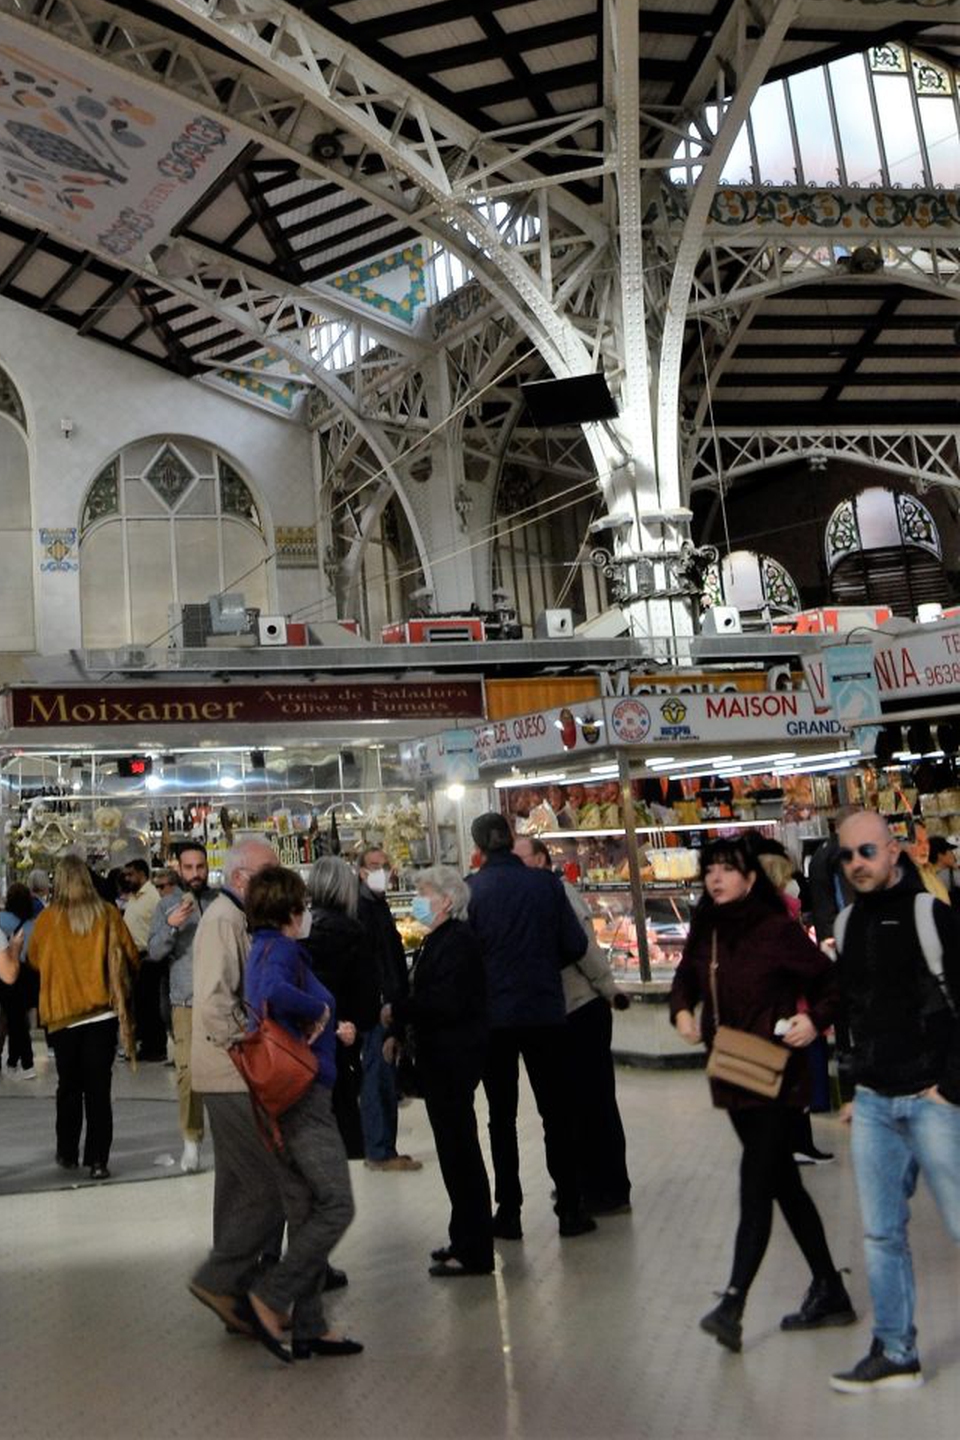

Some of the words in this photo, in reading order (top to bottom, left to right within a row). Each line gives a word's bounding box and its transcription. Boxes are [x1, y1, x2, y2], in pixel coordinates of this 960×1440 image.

[338, 689, 363, 700] de
[27, 693, 243, 723] Moixamer
[281, 701, 349, 714] Olives
[706, 696, 797, 719] MAISON
[513, 714, 547, 741] QUESO
